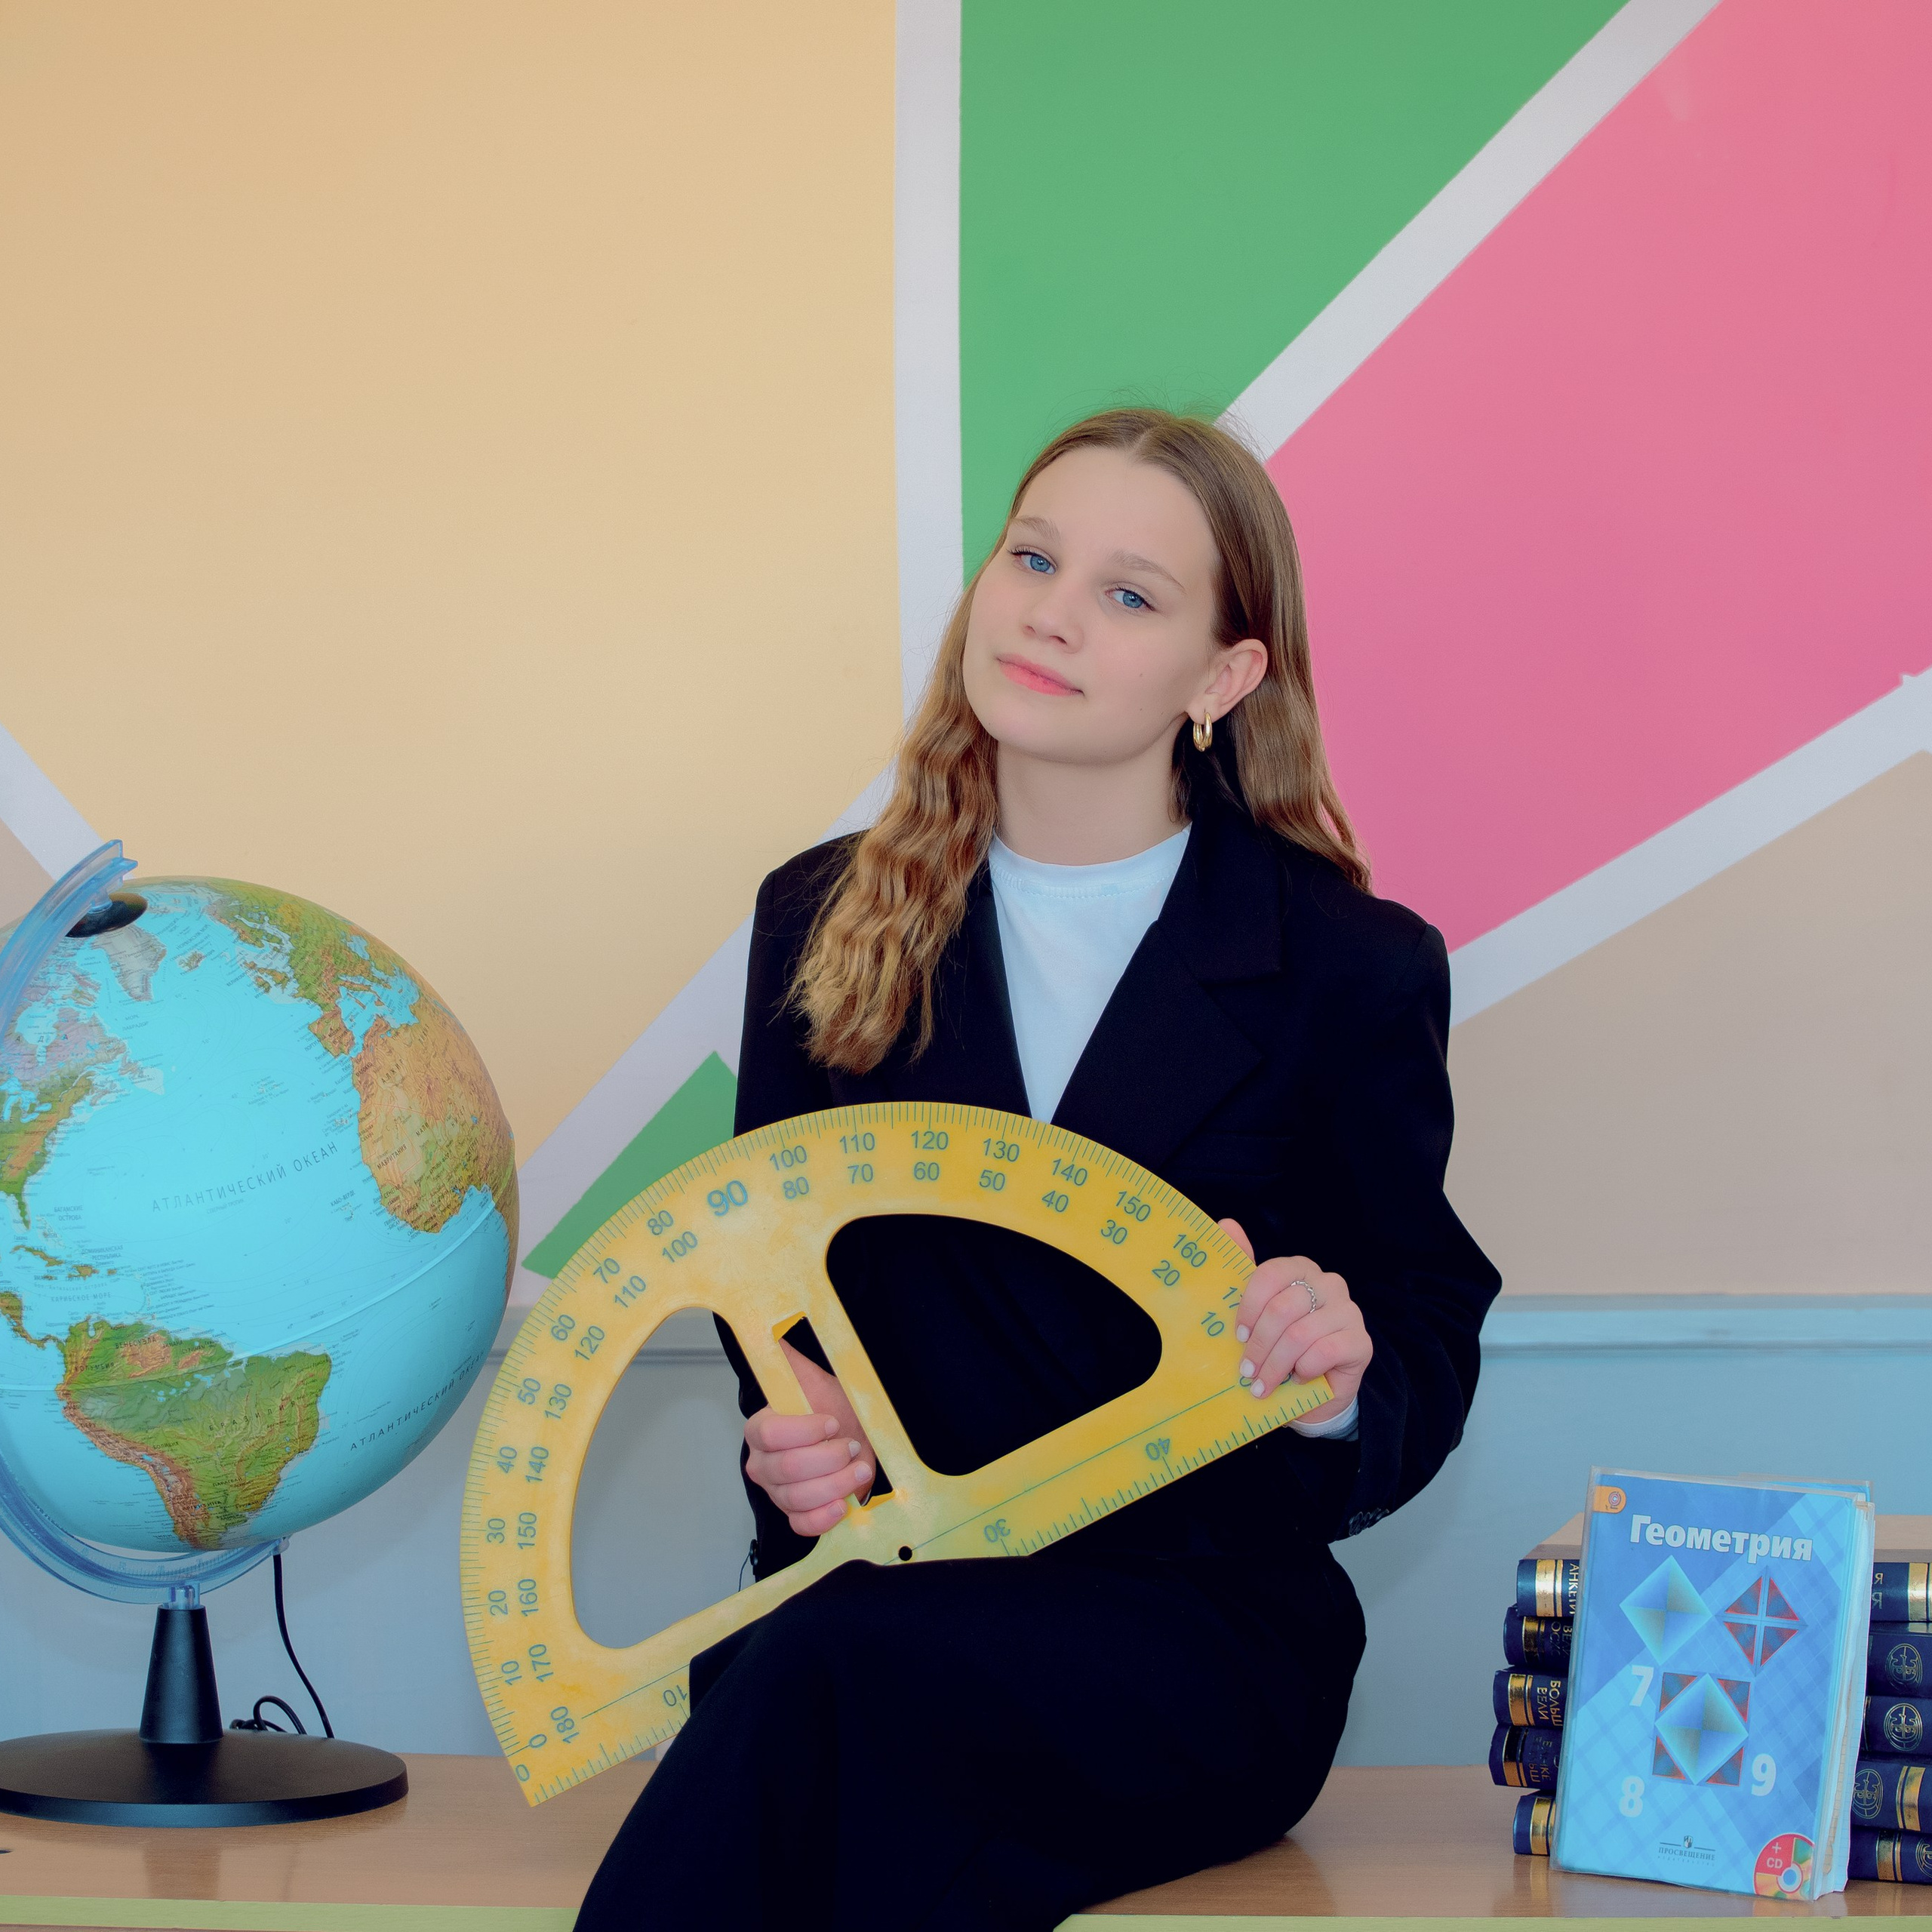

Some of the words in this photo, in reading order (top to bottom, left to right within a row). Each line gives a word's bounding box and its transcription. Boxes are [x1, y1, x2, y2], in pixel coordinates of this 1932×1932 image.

[840, 1132, 875, 1153] 110
[912, 1129, 949, 1150] 120
[983, 1138, 1020, 1163] 130
[377, 1143, 408, 1170] МАВРИТАНИЯ
[770, 1146, 807, 1171] 100
[152, 1164, 287, 1212] АТЛАНТИЧЕСКИЙ
[293, 1142, 338, 1172] ОКЕАН
[848, 1164, 873, 1183] 70
[913, 1162, 940, 1181] 60
[979, 1170, 1005, 1192] 50
[1053, 1158, 1088, 1186] 140
[707, 1180, 748, 1217] 90
[783, 1177, 809, 1199] 80
[1042, 1190, 1069, 1213] 40
[1114, 1191, 1151, 1222] 150
[647, 1211, 674, 1235] 80
[1100, 1220, 1128, 1245] 30
[662, 1230, 698, 1263] 100
[1172, 1233, 1208, 1269] 160
[593, 1258, 620, 1284] 70
[1152, 1260, 1180, 1287] 20
[51, 1294, 90, 1303] КАРИБСКОЕ
[94, 1291, 112, 1300] МОРЕ
[615, 1275, 647, 1306] 110
[551, 1315, 575, 1341] 60
[1201, 1312, 1225, 1337] 10
[115, 1335, 157, 1349] ВЕНЕСУЭЛА
[574, 1325, 605, 1361] 120
[518, 1378, 540, 1404] 50
[544, 1383, 572, 1419] 130
[349, 1378, 455, 1451] АТЛАНТИЧЕСКИЙ
[497, 1447, 517, 1472] 40
[1146, 1438, 1170, 1460] 40
[525, 1447, 548, 1481] 140
[486, 1518, 504, 1543] 30
[518, 1512, 536, 1549] 150
[983, 1519, 1011, 1543] 30
[1629, 1513, 1813, 1564] Геометрия
[488, 1590, 508, 1615] 20
[517, 1579, 538, 1616] 160
[501, 1661, 521, 1684] 10
[528, 1644, 552, 1681] 170
[663, 1686, 688, 1707] 10
[1629, 1664, 1654, 1707] 7
[551, 1706, 579, 1743] 180
[528, 1734, 547, 1749] 0
[514, 1764, 530, 1783] 0
[1751, 1753, 1777, 1797] 9
[1619, 1775, 1645, 1818] 8
[1658, 1846, 1715, 1861] ПРОСВЕЩЕНИЕ
[1766, 1857, 1783, 1869] CD
